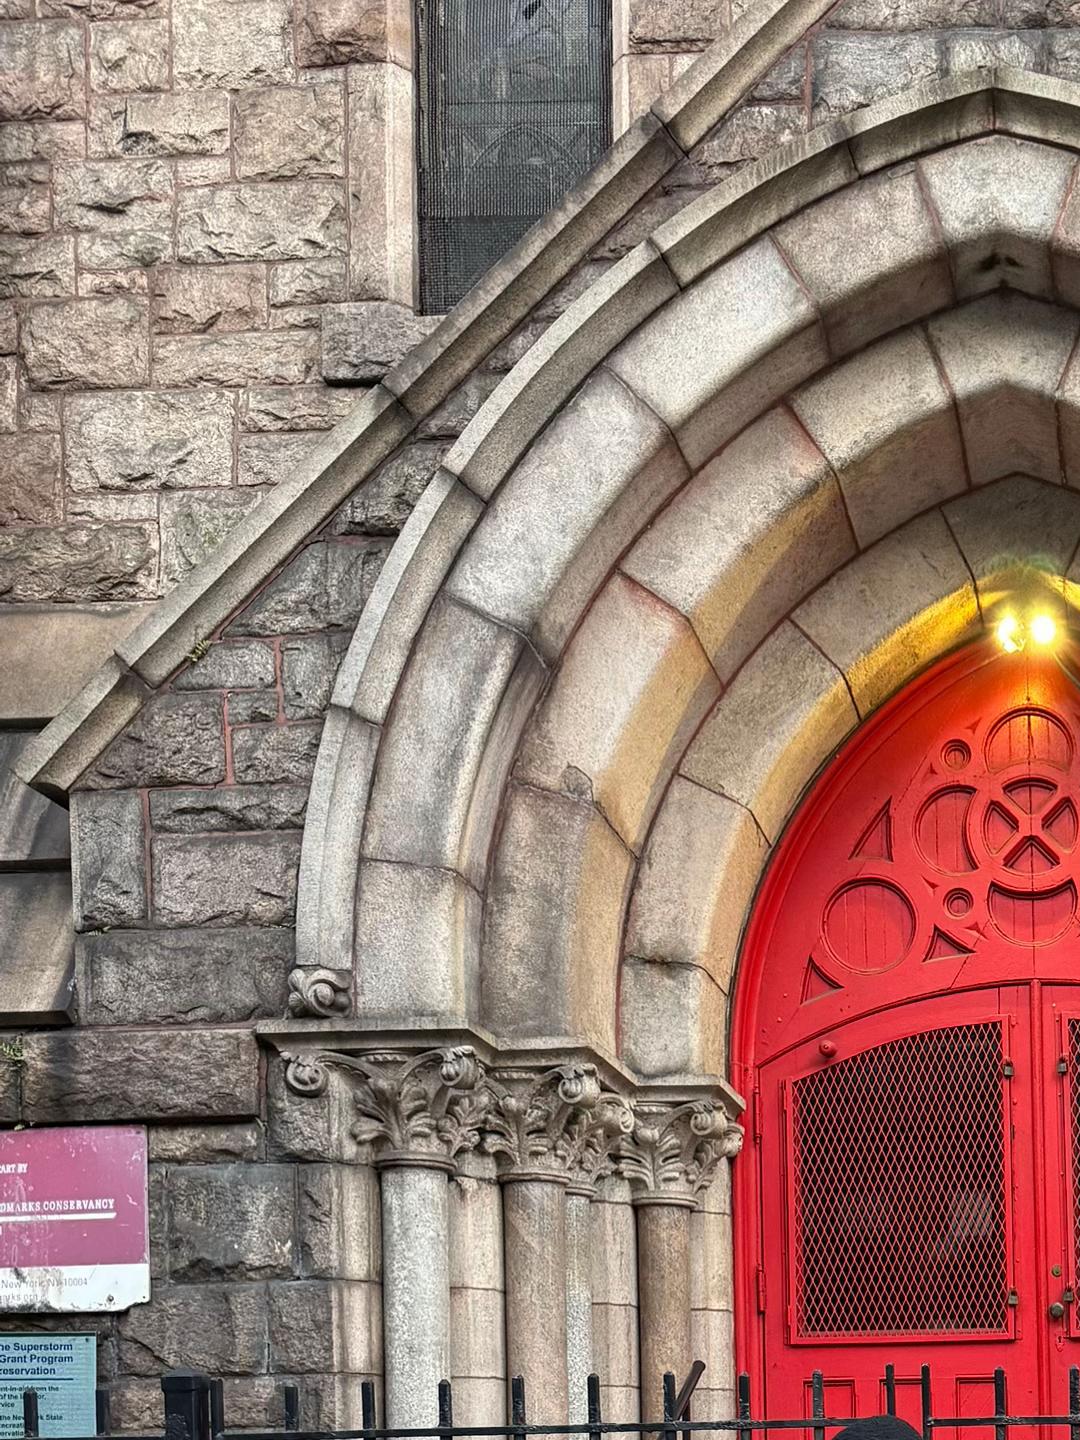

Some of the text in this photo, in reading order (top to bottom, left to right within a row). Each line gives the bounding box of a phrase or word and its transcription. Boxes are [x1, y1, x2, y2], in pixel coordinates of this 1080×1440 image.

[17, 1162, 28, 1173] BY
[43, 1198, 115, 1211] CONSERVANCY
[13, 1342, 73, 1353] Superstorm
[0, 1354, 74, 1365] Grant Program
